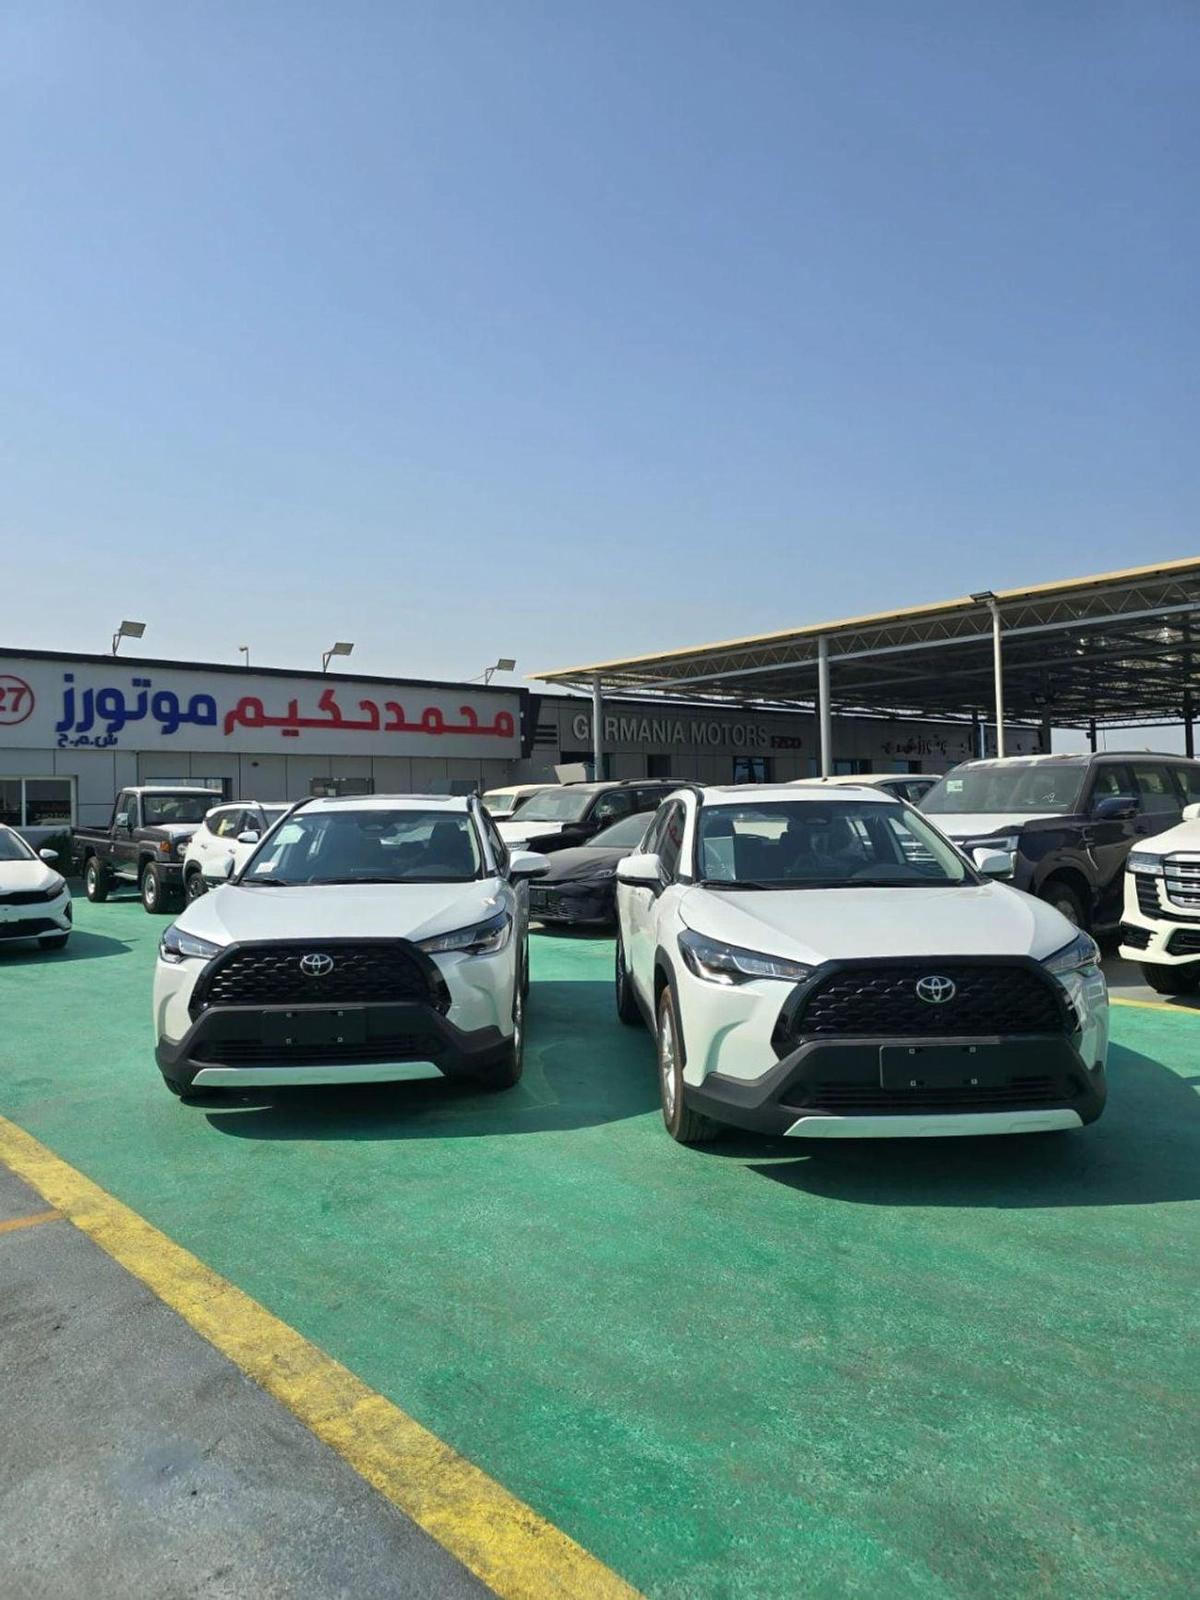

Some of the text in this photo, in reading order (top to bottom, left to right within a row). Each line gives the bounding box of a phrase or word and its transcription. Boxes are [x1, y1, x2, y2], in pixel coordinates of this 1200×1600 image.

[55, 673, 217, 735] موتورز
[573, 714, 686, 744] GRMANIA
[691, 721, 768, 748] MOTORS
